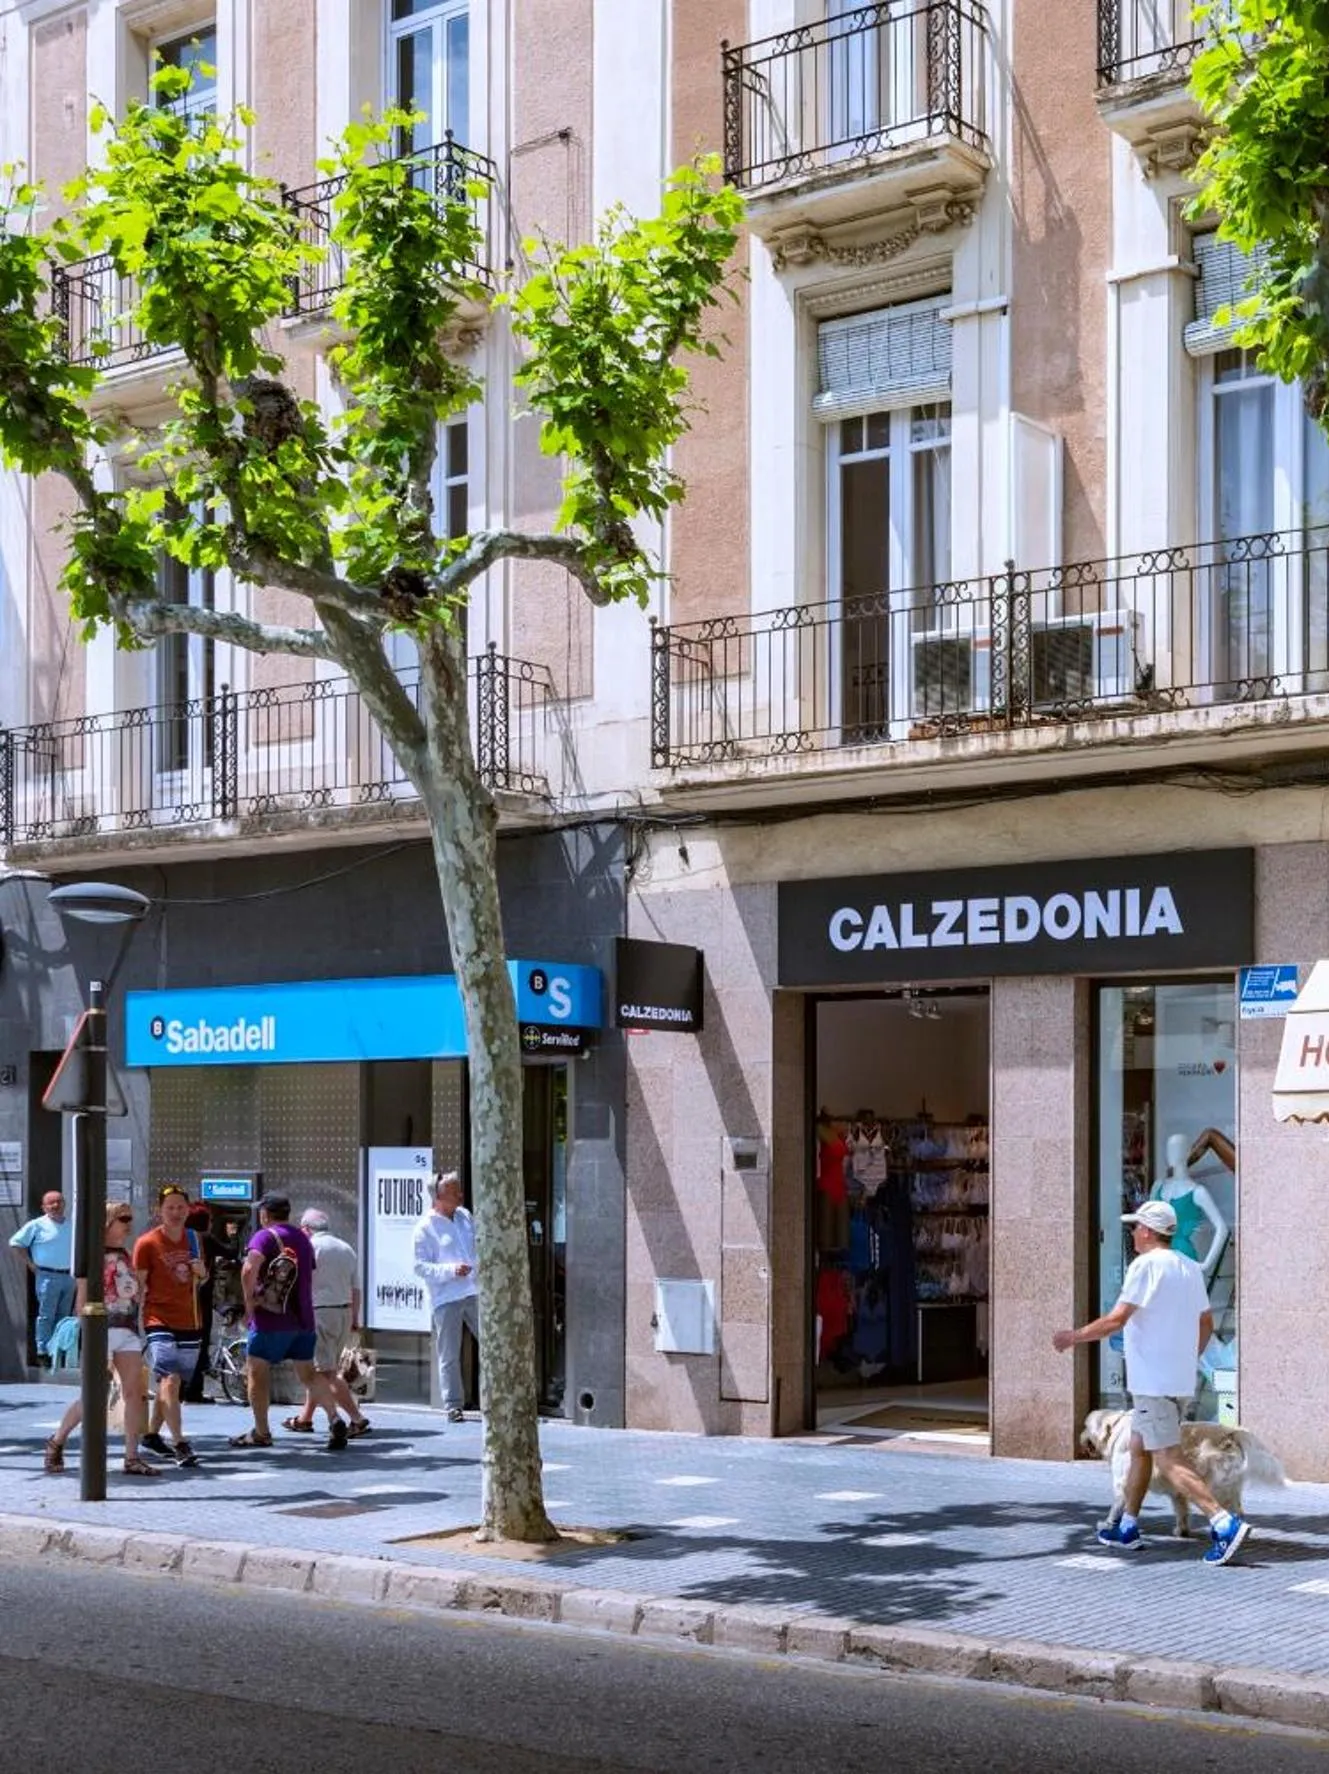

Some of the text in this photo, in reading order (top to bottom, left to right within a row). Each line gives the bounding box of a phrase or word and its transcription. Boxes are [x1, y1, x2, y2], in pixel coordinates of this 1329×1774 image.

[828, 885, 1184, 952] CALZEDONIA
[549, 977, 571, 1019] S
[621, 1004, 693, 1022] CALZEDONIA
[166, 1015, 276, 1054] Sabadell
[377, 1178, 423, 1216] FUTURS
